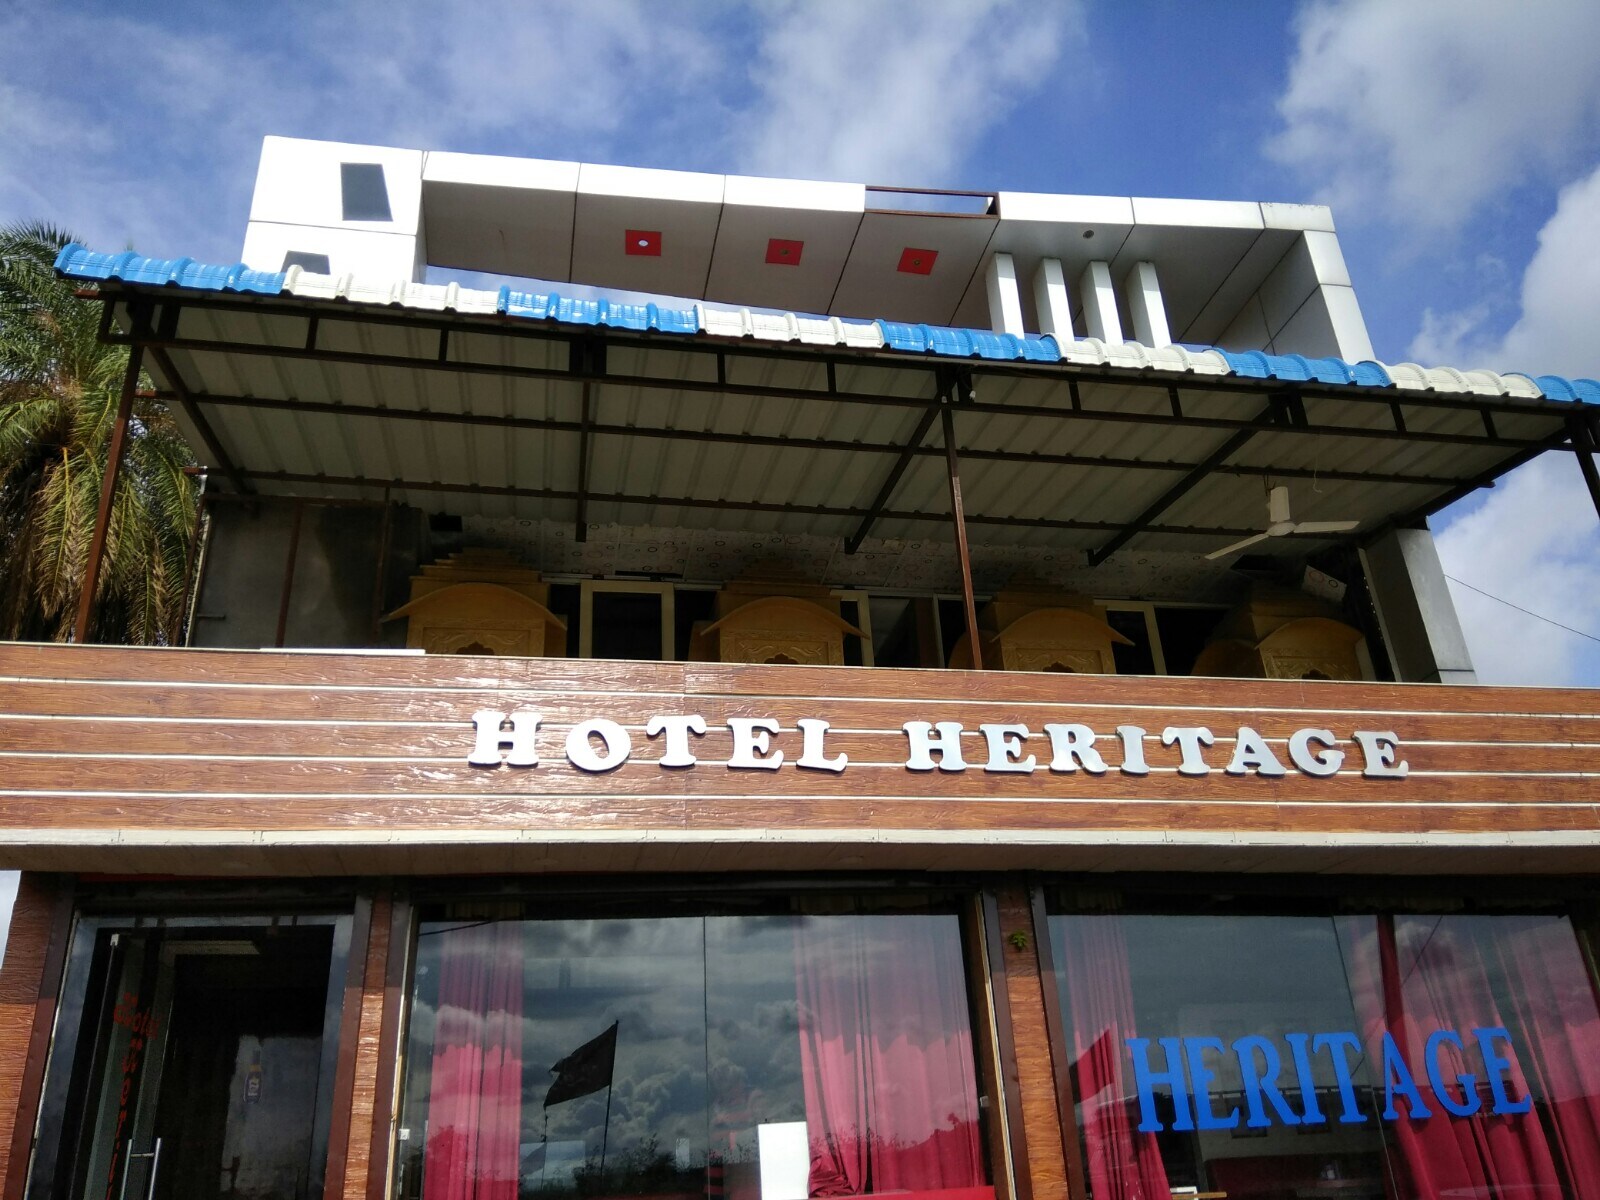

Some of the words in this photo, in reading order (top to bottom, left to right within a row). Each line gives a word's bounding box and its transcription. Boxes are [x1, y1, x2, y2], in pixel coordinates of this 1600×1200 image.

[467, 710, 849, 772] HOTEL
[902, 720, 1410, 779] HERITAGE
[1125, 1027, 1532, 1133] HERITAGE
